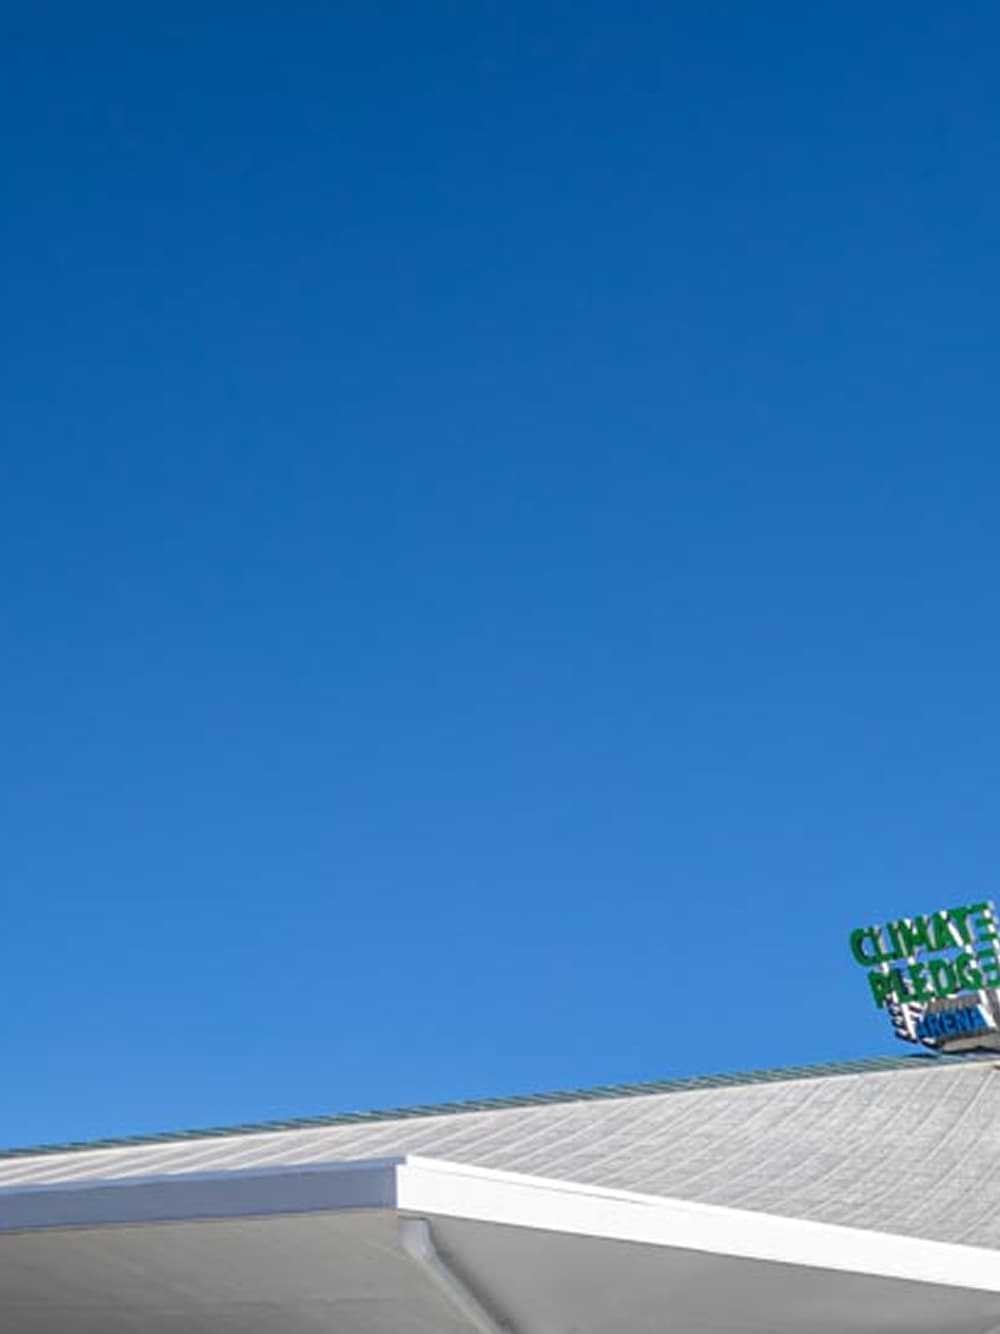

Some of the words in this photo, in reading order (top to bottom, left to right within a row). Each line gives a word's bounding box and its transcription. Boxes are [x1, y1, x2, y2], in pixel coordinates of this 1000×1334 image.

[849, 901, 1000, 966] CLIMATE
[867, 948, 1000, 1008] PLEDGE
[914, 1003, 987, 1040] ARENA
